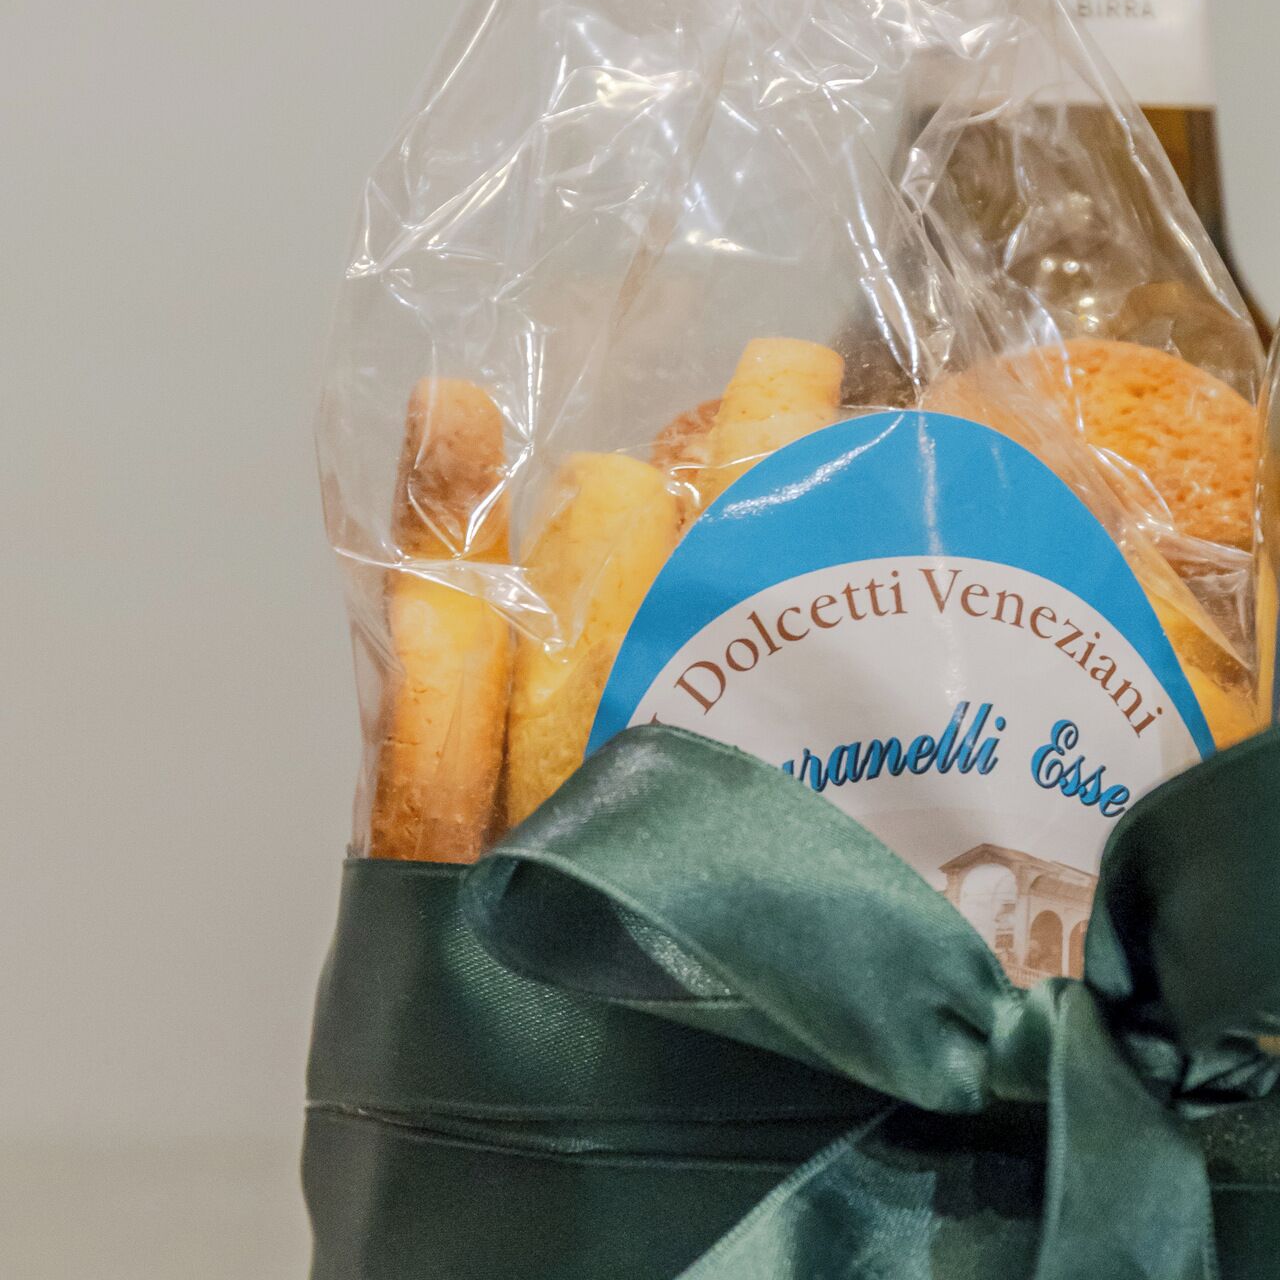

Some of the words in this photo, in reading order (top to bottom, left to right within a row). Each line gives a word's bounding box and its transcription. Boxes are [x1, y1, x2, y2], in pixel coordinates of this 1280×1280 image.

[672, 569, 909, 715] Dolcetti
[917, 568, 1164, 739] Veneziani
[1030, 718, 1131, 818] Esse
